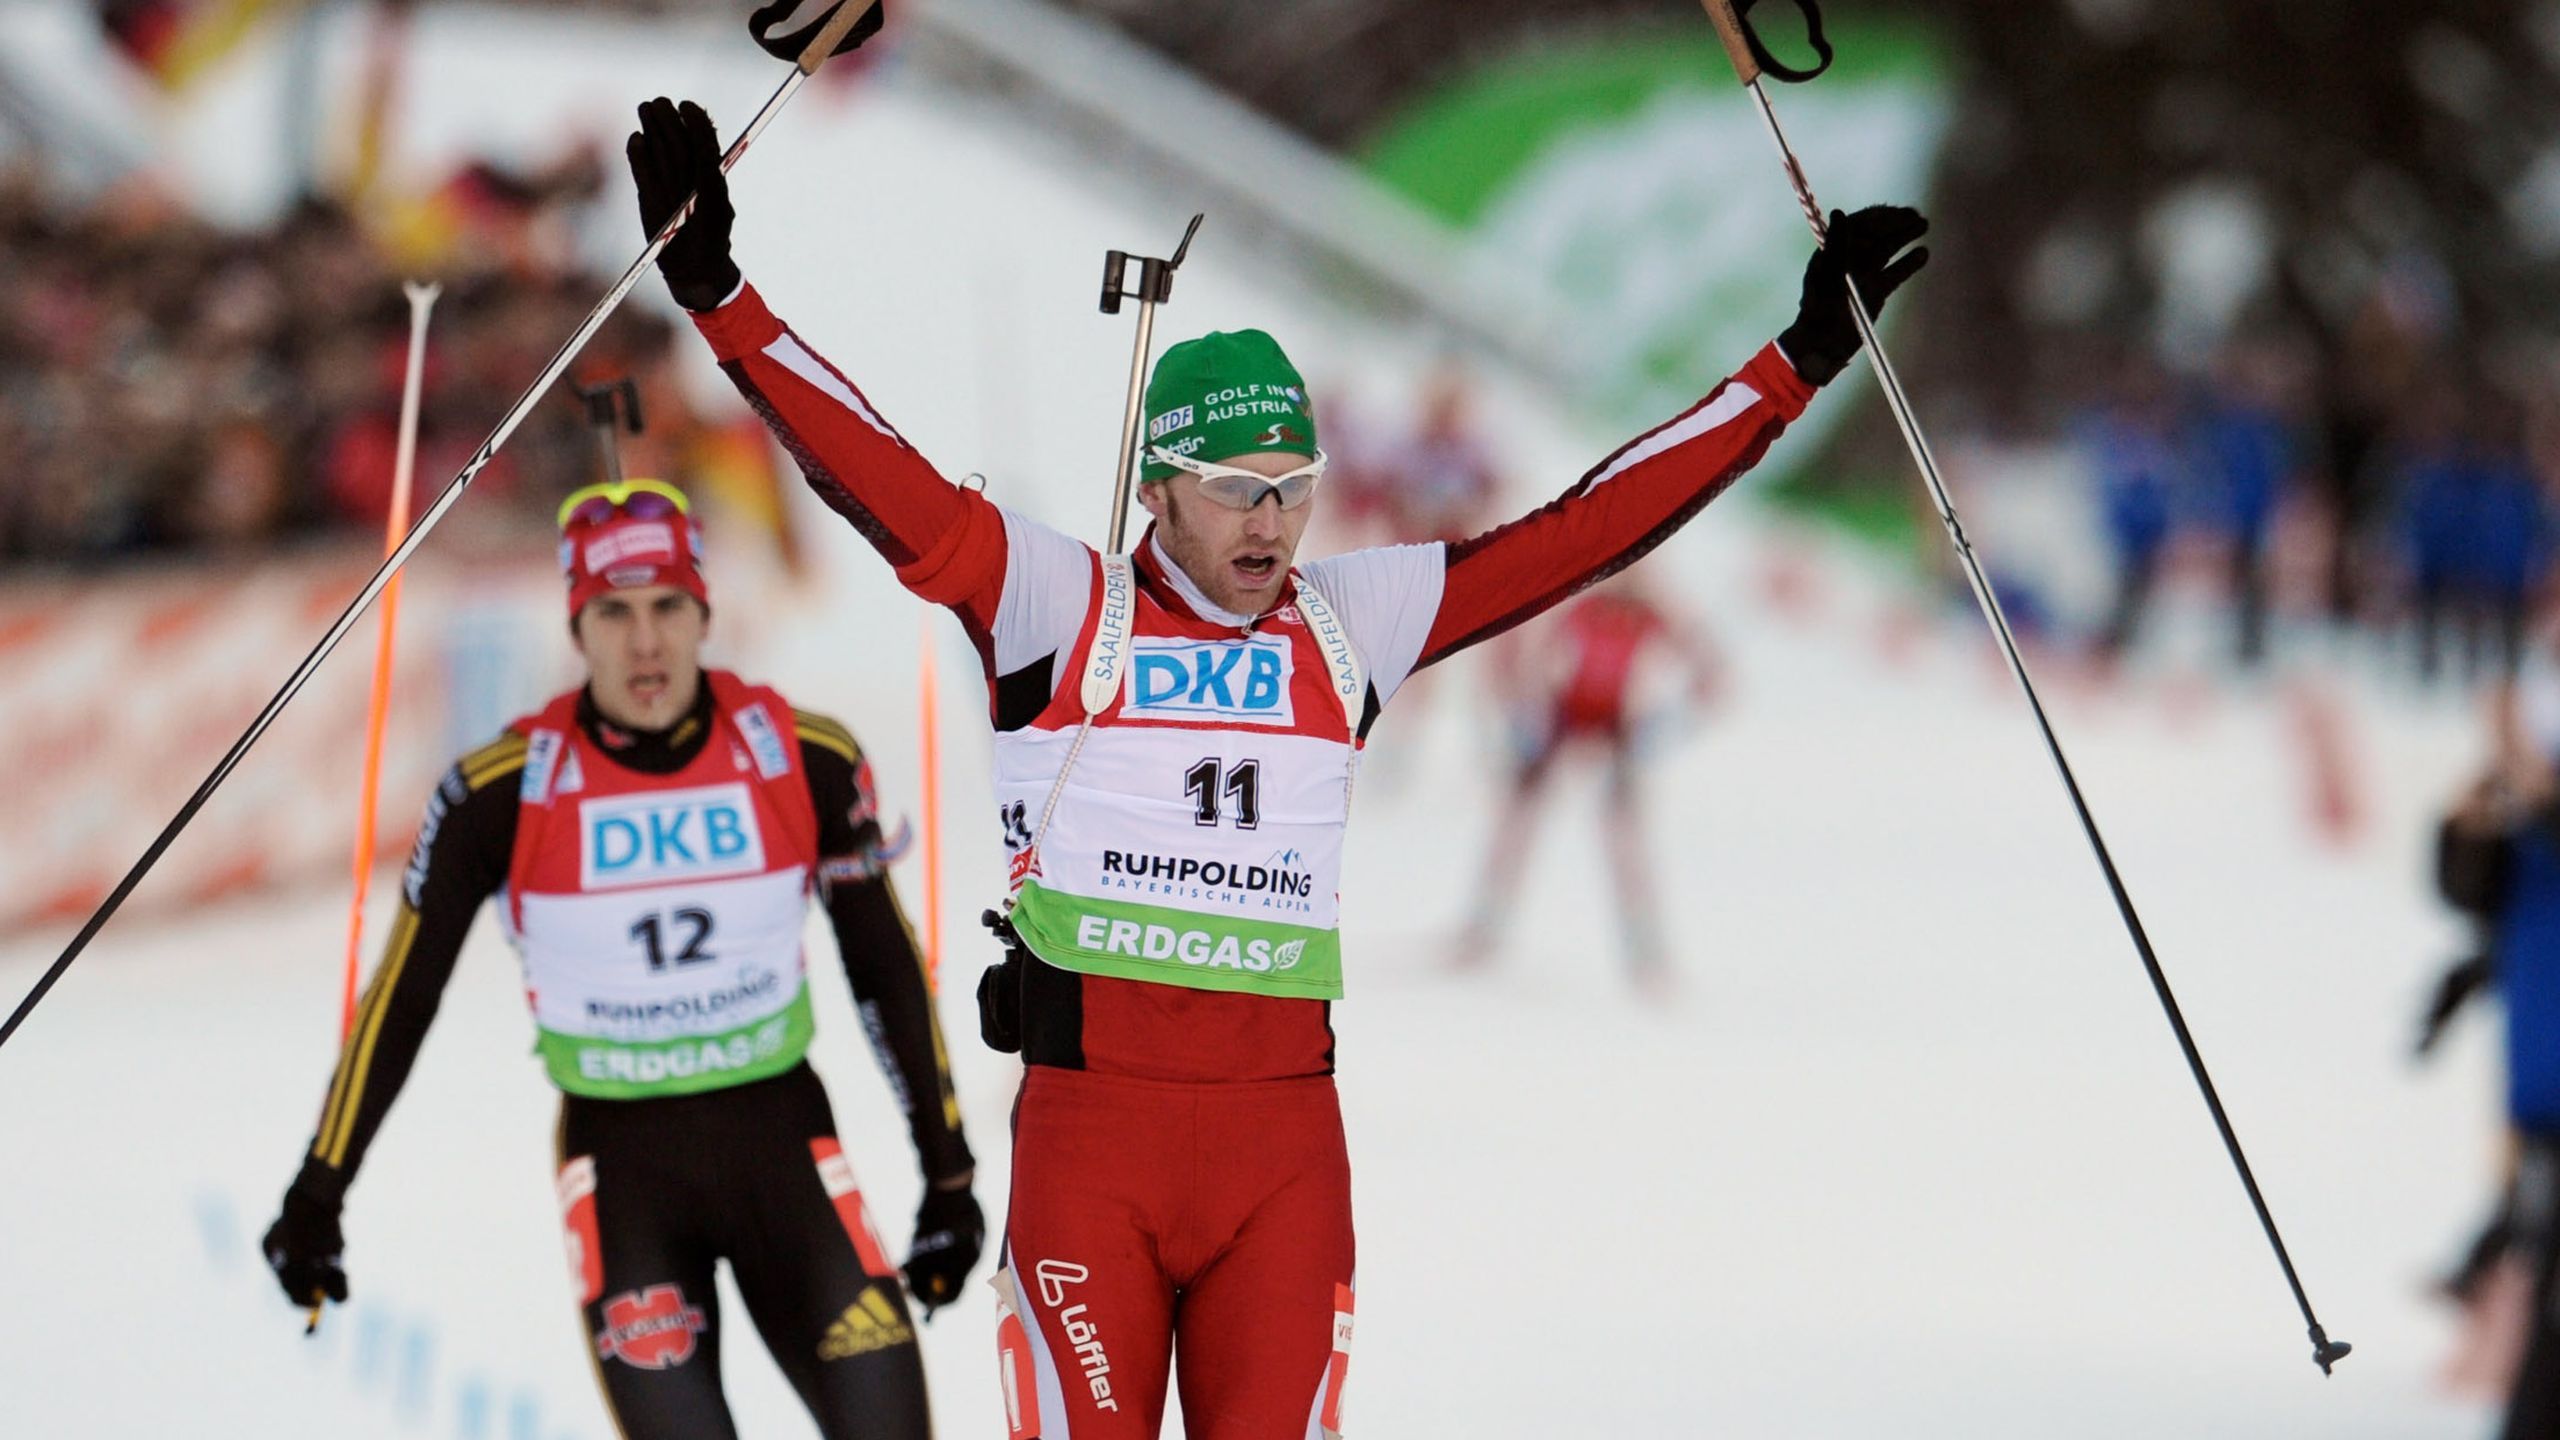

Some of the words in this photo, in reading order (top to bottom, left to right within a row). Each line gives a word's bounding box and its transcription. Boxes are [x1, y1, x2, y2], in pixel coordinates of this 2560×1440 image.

[1204, 384, 1260, 405] GOLF
[1266, 384, 1285, 397] IN
[1206, 400, 1293, 424] AUSTRIA
[1094, 570, 1126, 680] SAALFELDEN
[1299, 584, 1357, 695] SAALFELDEN
[1134, 647, 1282, 710] DKB
[1184, 757, 1260, 830] 11
[592, 805, 747, 873] DKB
[1101, 875, 1246, 905] BAYERISCHE
[1263, 897, 1310, 912] ALPIN
[1103, 850, 1311, 898] RUHPOLDING
[629, 907, 718, 972] 12
[1077, 914, 1271, 971] ERDGAS
[578, 1032, 752, 1084] ERDGAS
